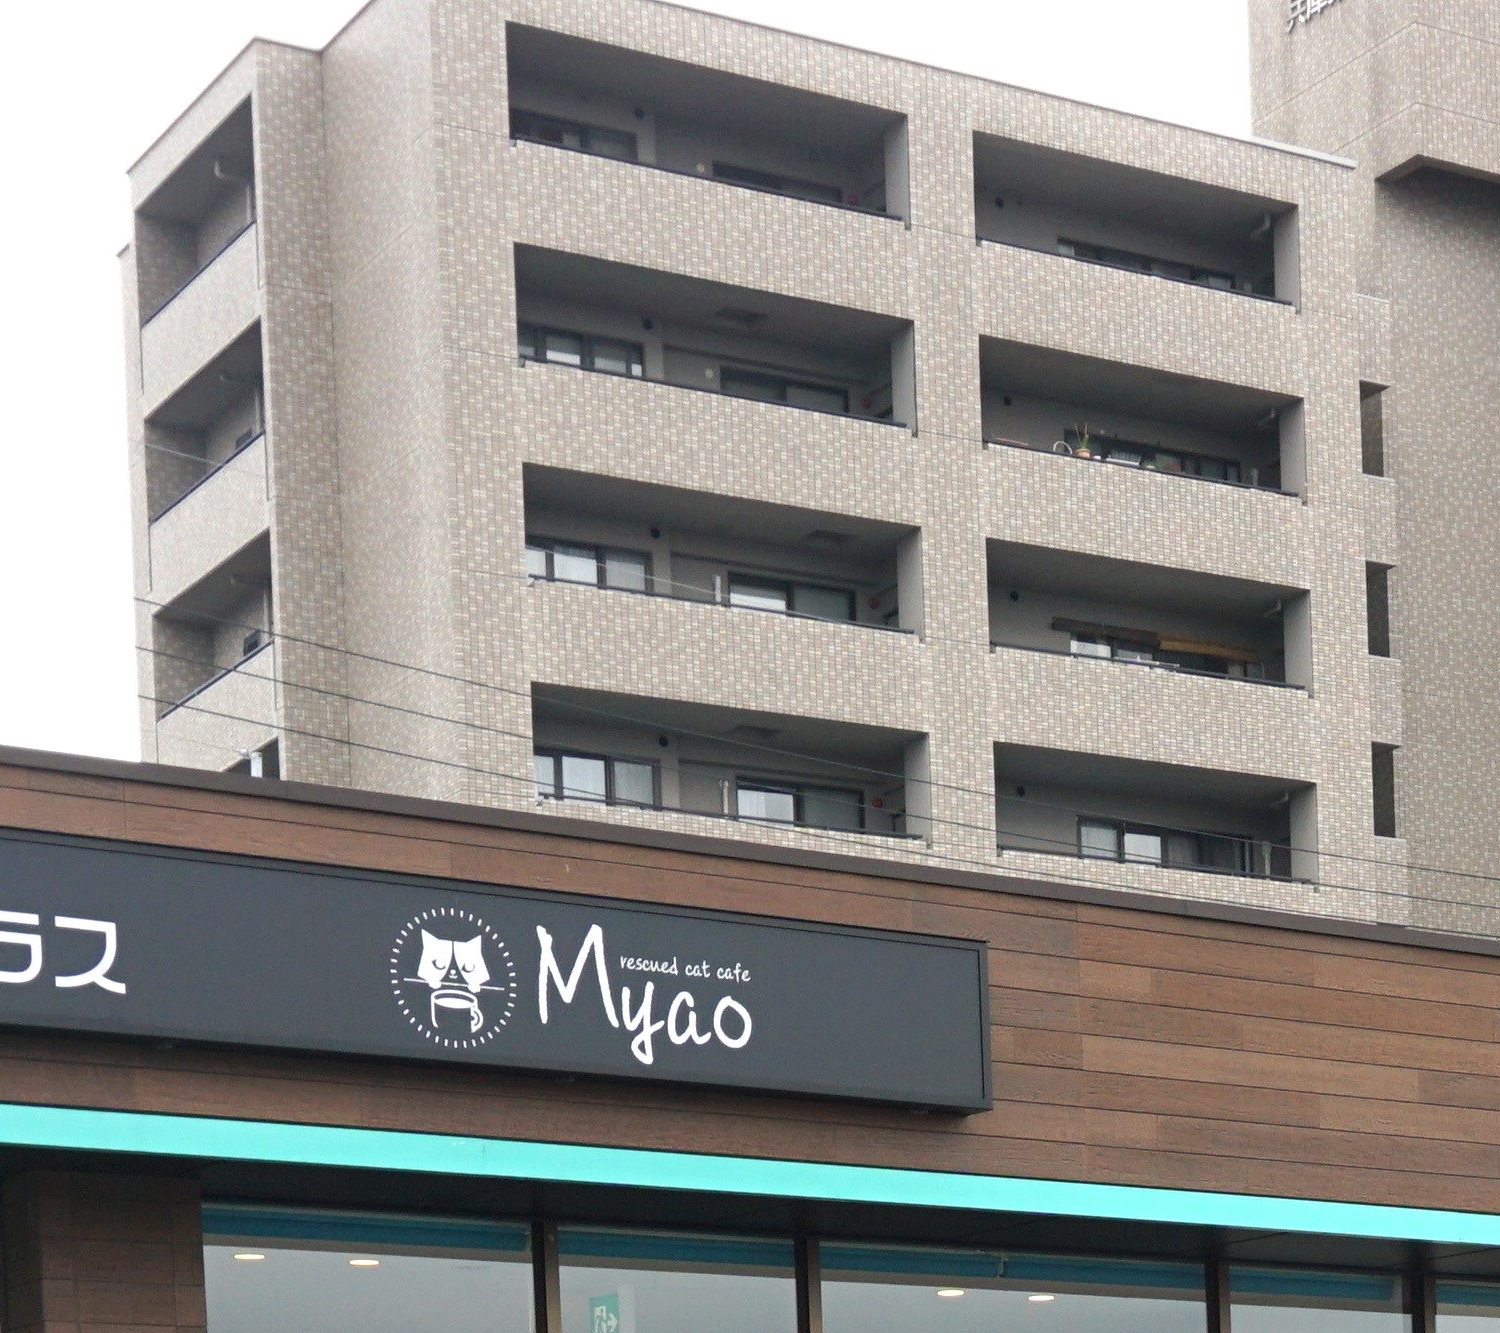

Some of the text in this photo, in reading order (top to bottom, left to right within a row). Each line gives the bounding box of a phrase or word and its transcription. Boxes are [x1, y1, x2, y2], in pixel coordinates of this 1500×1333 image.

[536, 923, 753, 1065] Myao
[620, 956, 752, 983] rescued cat cafe
